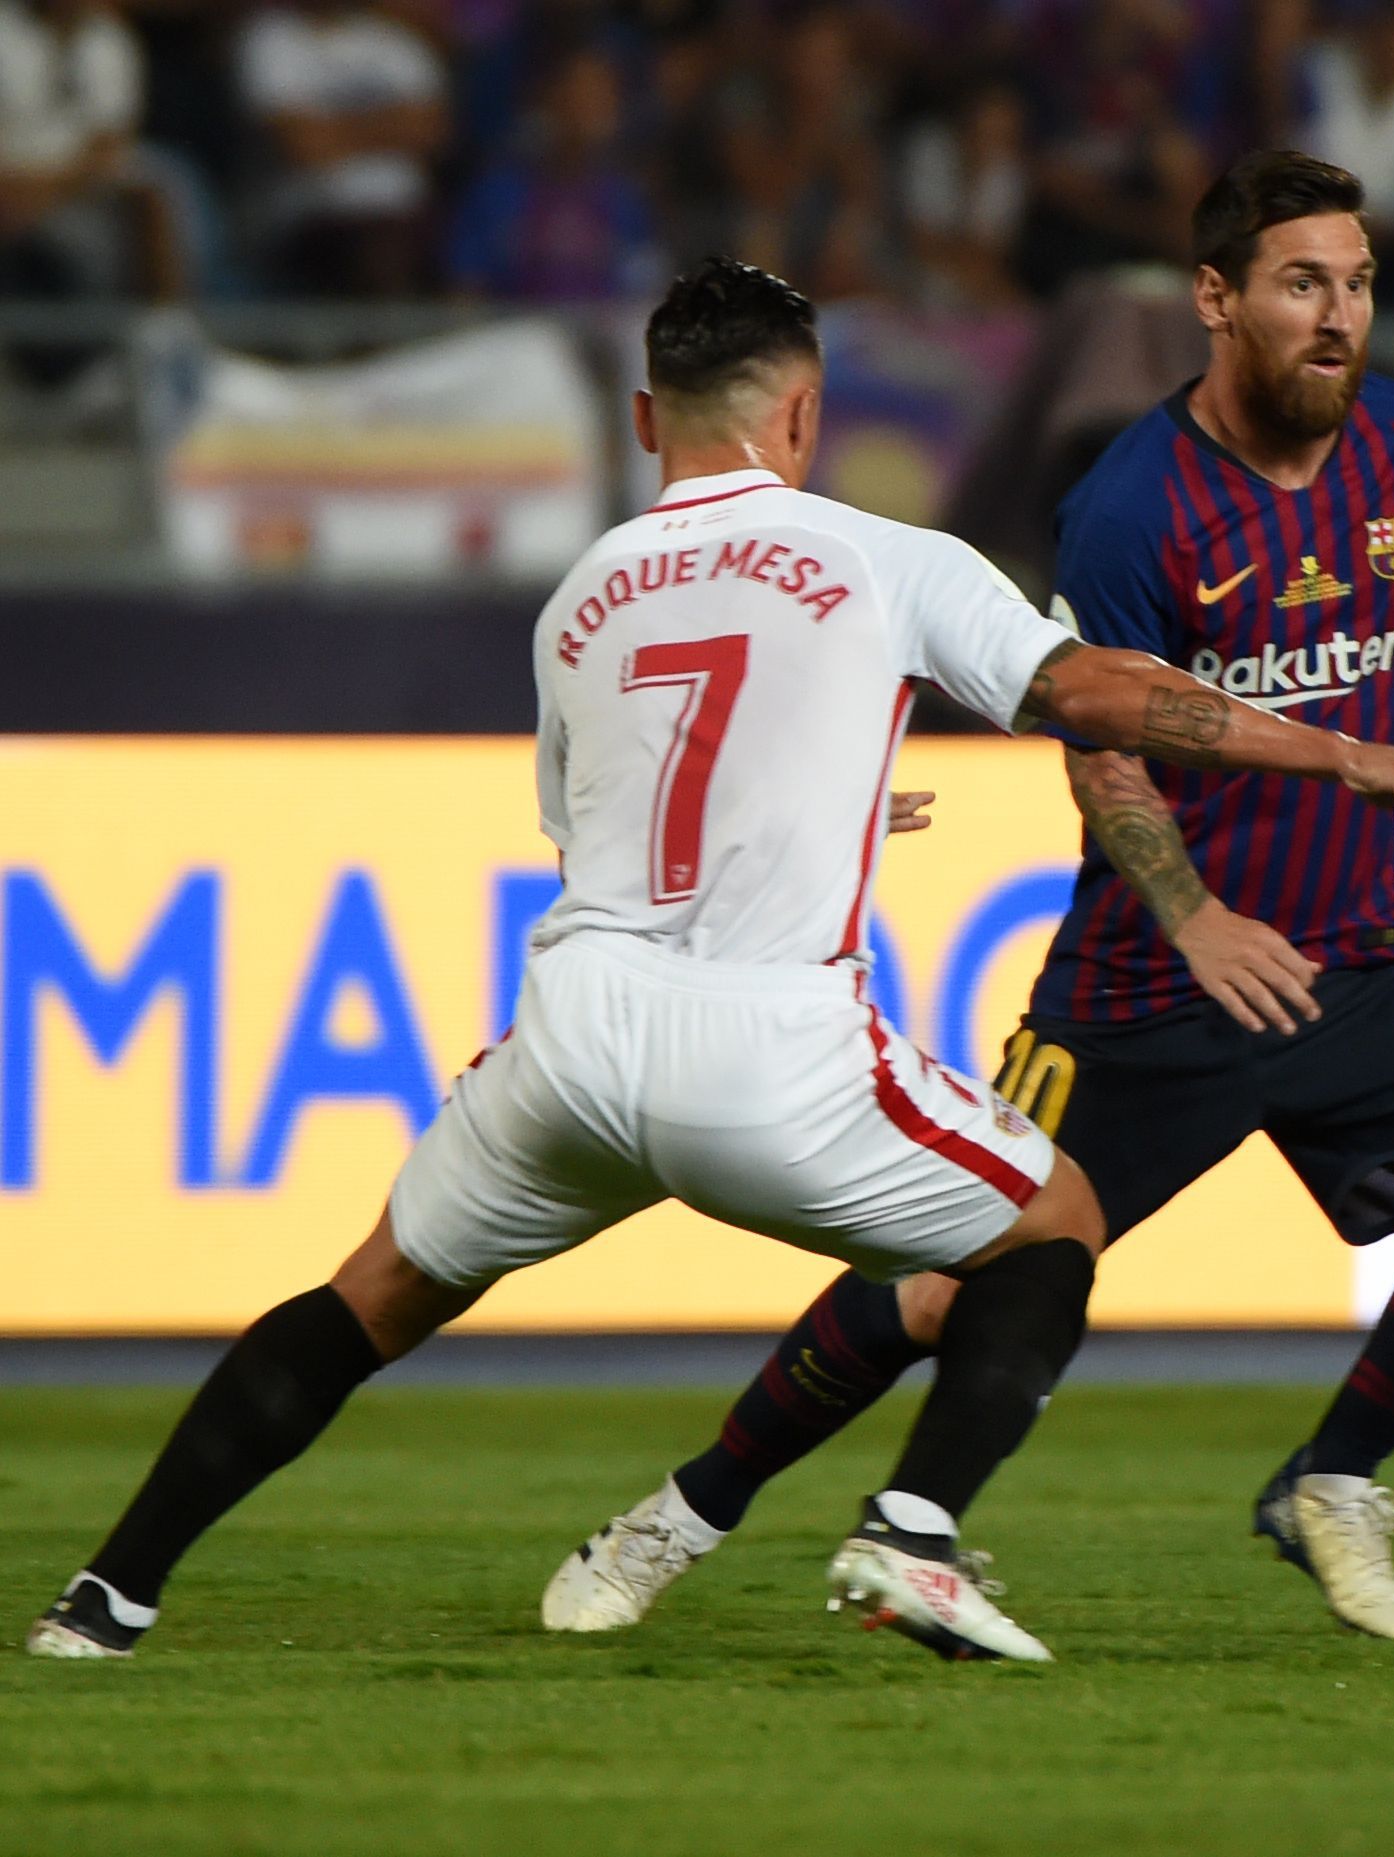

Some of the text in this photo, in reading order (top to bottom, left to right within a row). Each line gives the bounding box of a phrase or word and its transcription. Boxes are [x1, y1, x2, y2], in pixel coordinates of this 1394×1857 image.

[557, 539, 853, 670] ROQUE MESA
[619, 633, 751, 906] 7
[1000, 1028, 1076, 1140] 10
